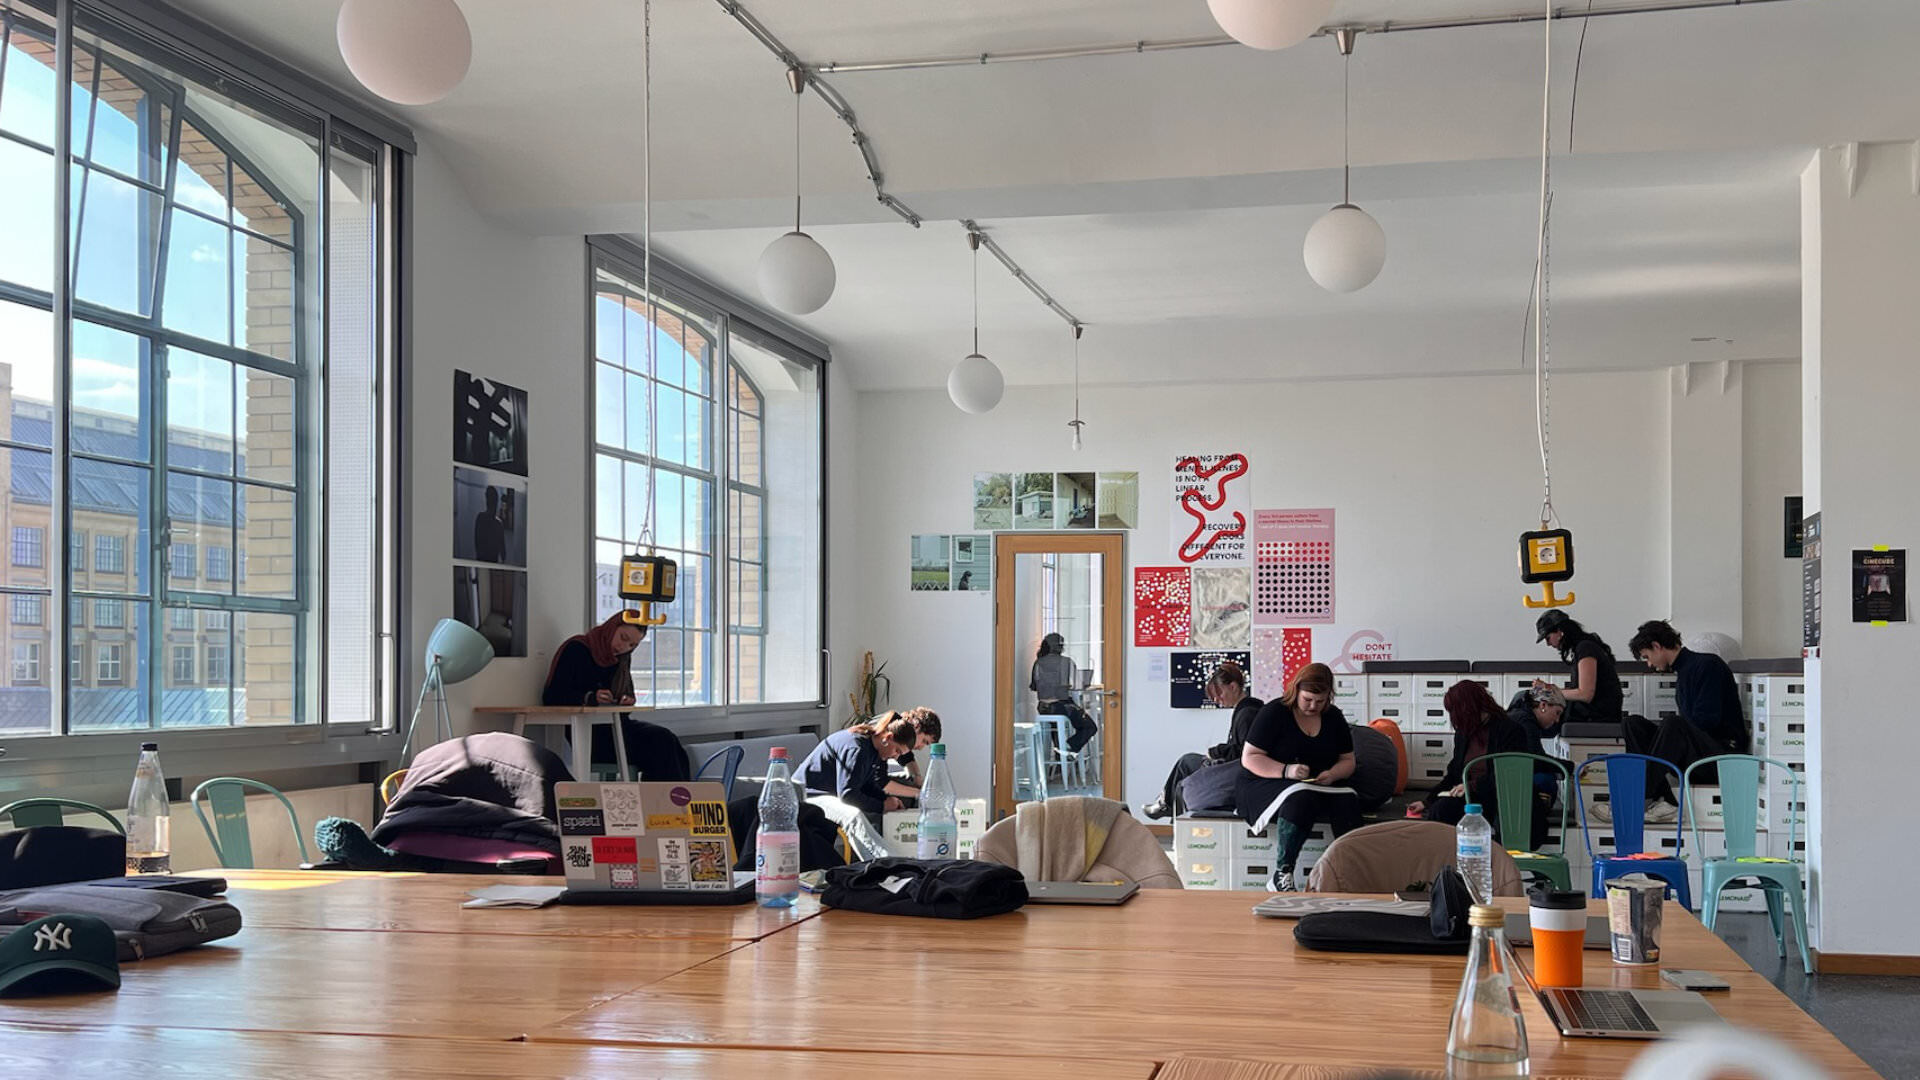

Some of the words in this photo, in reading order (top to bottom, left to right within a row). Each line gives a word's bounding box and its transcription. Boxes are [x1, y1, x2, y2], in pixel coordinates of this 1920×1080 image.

[1175, 455, 1212, 463] HEALING
[1228, 542, 1245, 550] FOR
[1365, 643, 1393, 651] DON'T
[1352, 653, 1393, 661] HESITATE
[690, 803, 725, 826] WIND
[693, 826, 726, 834] BURGER
[34, 922, 73, 952] NY
